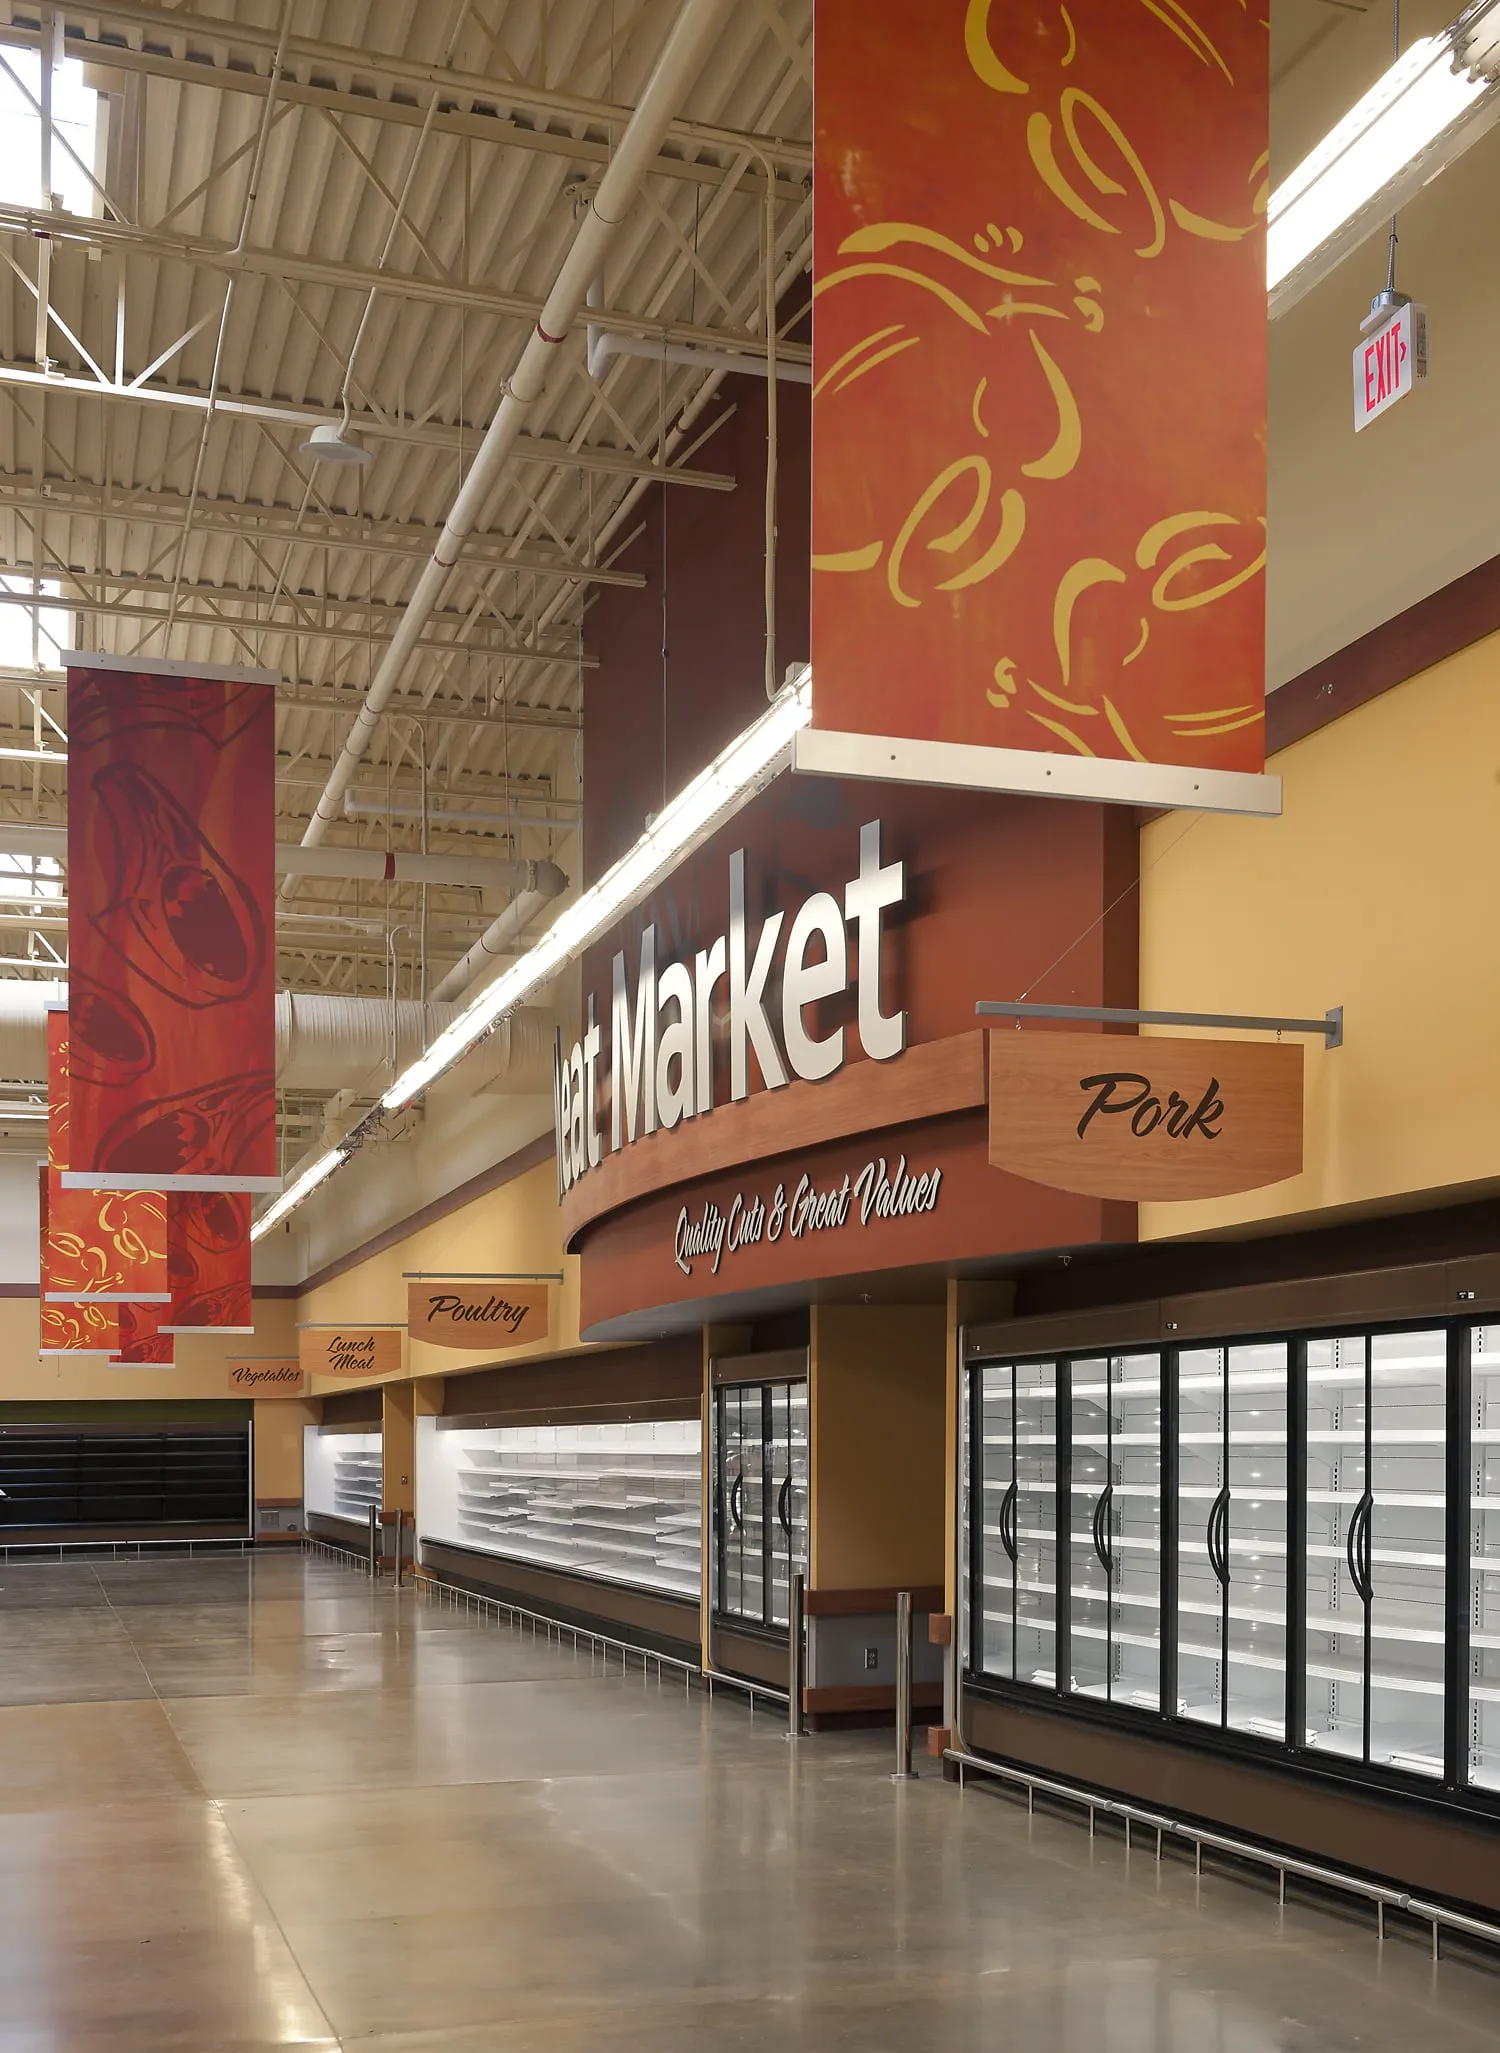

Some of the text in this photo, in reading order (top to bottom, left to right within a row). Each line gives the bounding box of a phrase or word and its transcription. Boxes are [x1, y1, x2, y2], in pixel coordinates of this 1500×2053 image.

[1365, 322, 1401, 413] EXIT
[612, 819, 905, 1153] Market
[1077, 1072, 1225, 1140] Pork
[674, 1153, 943, 1276] Quality Cuts & Great Values
[428, 1295, 530, 1333] Poultry
[326, 1336, 375, 1353] Lunch
[328, 1353, 375, 1371] Meat
[232, 1367, 300, 1387] Vegetables
